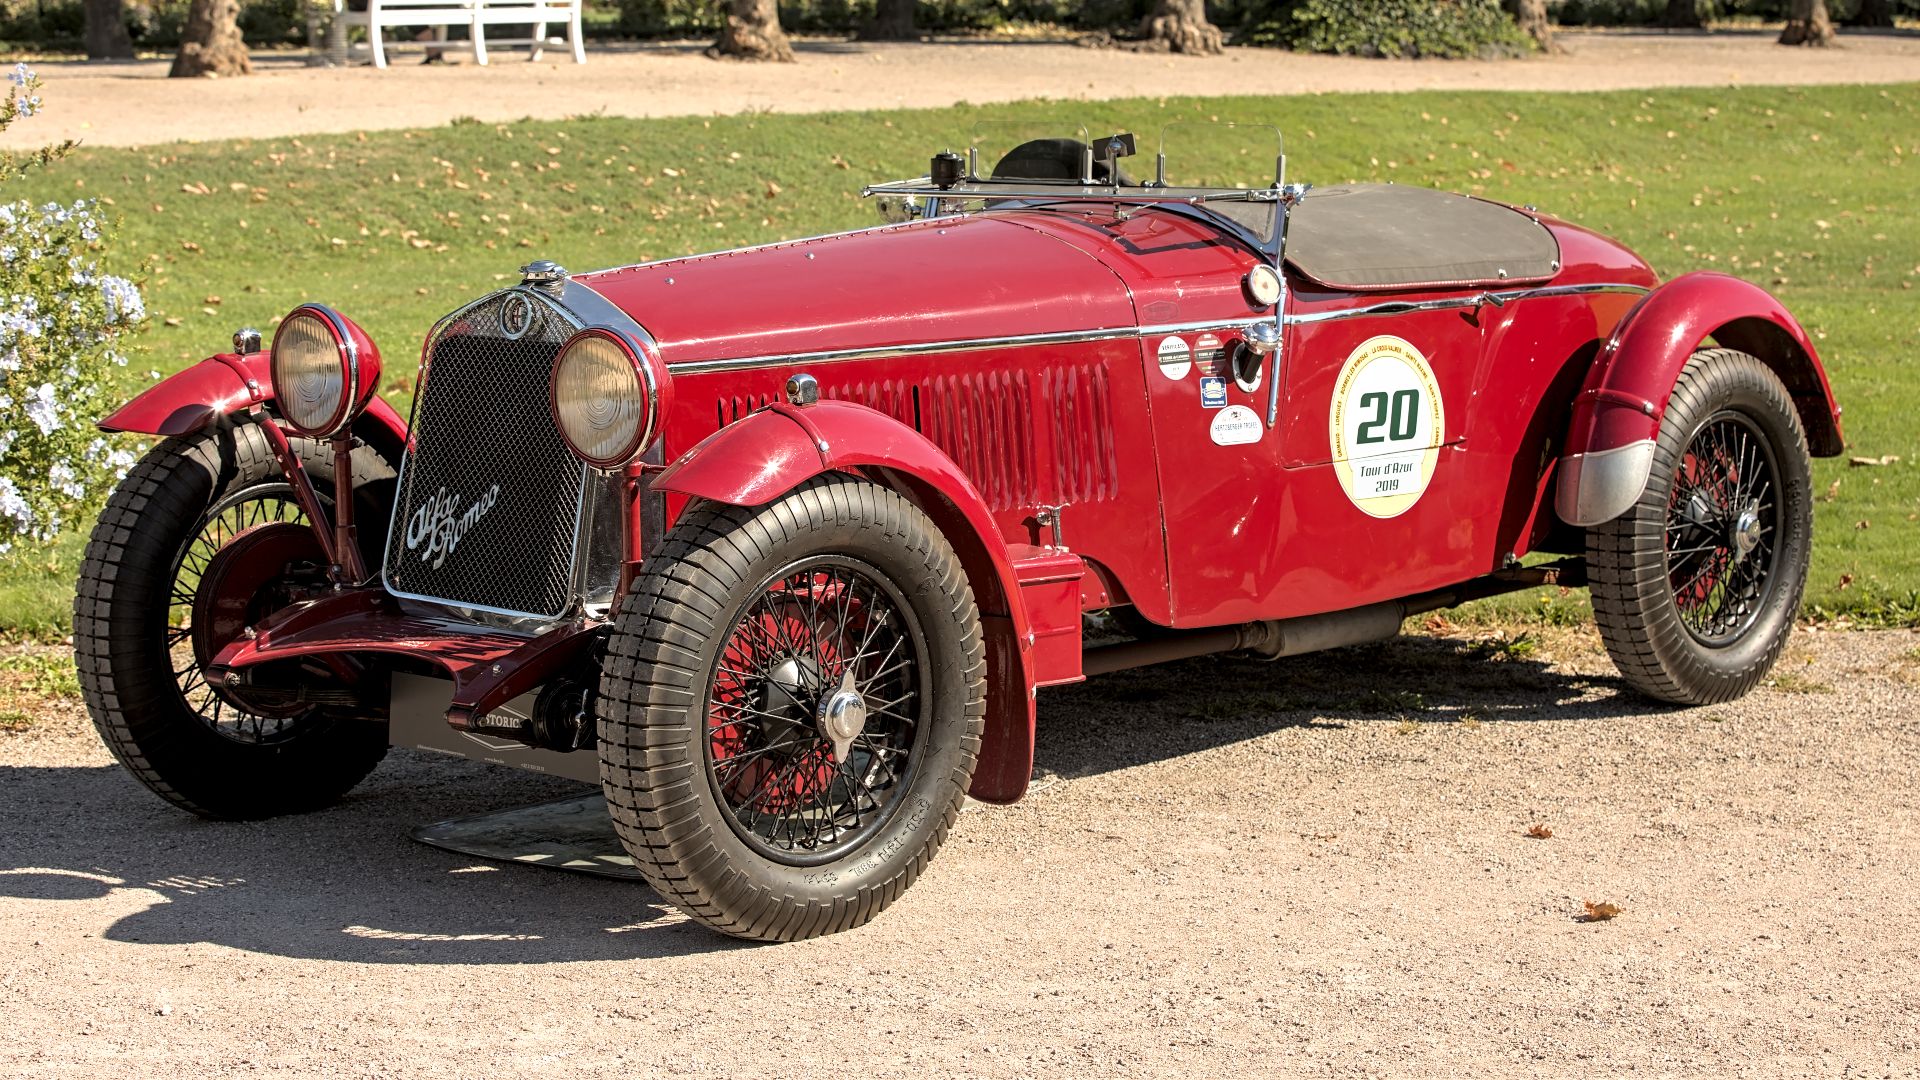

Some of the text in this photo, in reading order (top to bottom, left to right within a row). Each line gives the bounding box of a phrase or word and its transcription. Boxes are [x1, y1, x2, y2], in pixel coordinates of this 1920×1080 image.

[1357, 389, 1419, 444] 20
[1361, 462, 1414, 477] Tour d'Azur
[1376, 479, 1399, 493] 2019
[407, 484, 500, 570] Alfa Romeo
[486, 714, 520, 728] STORIC
